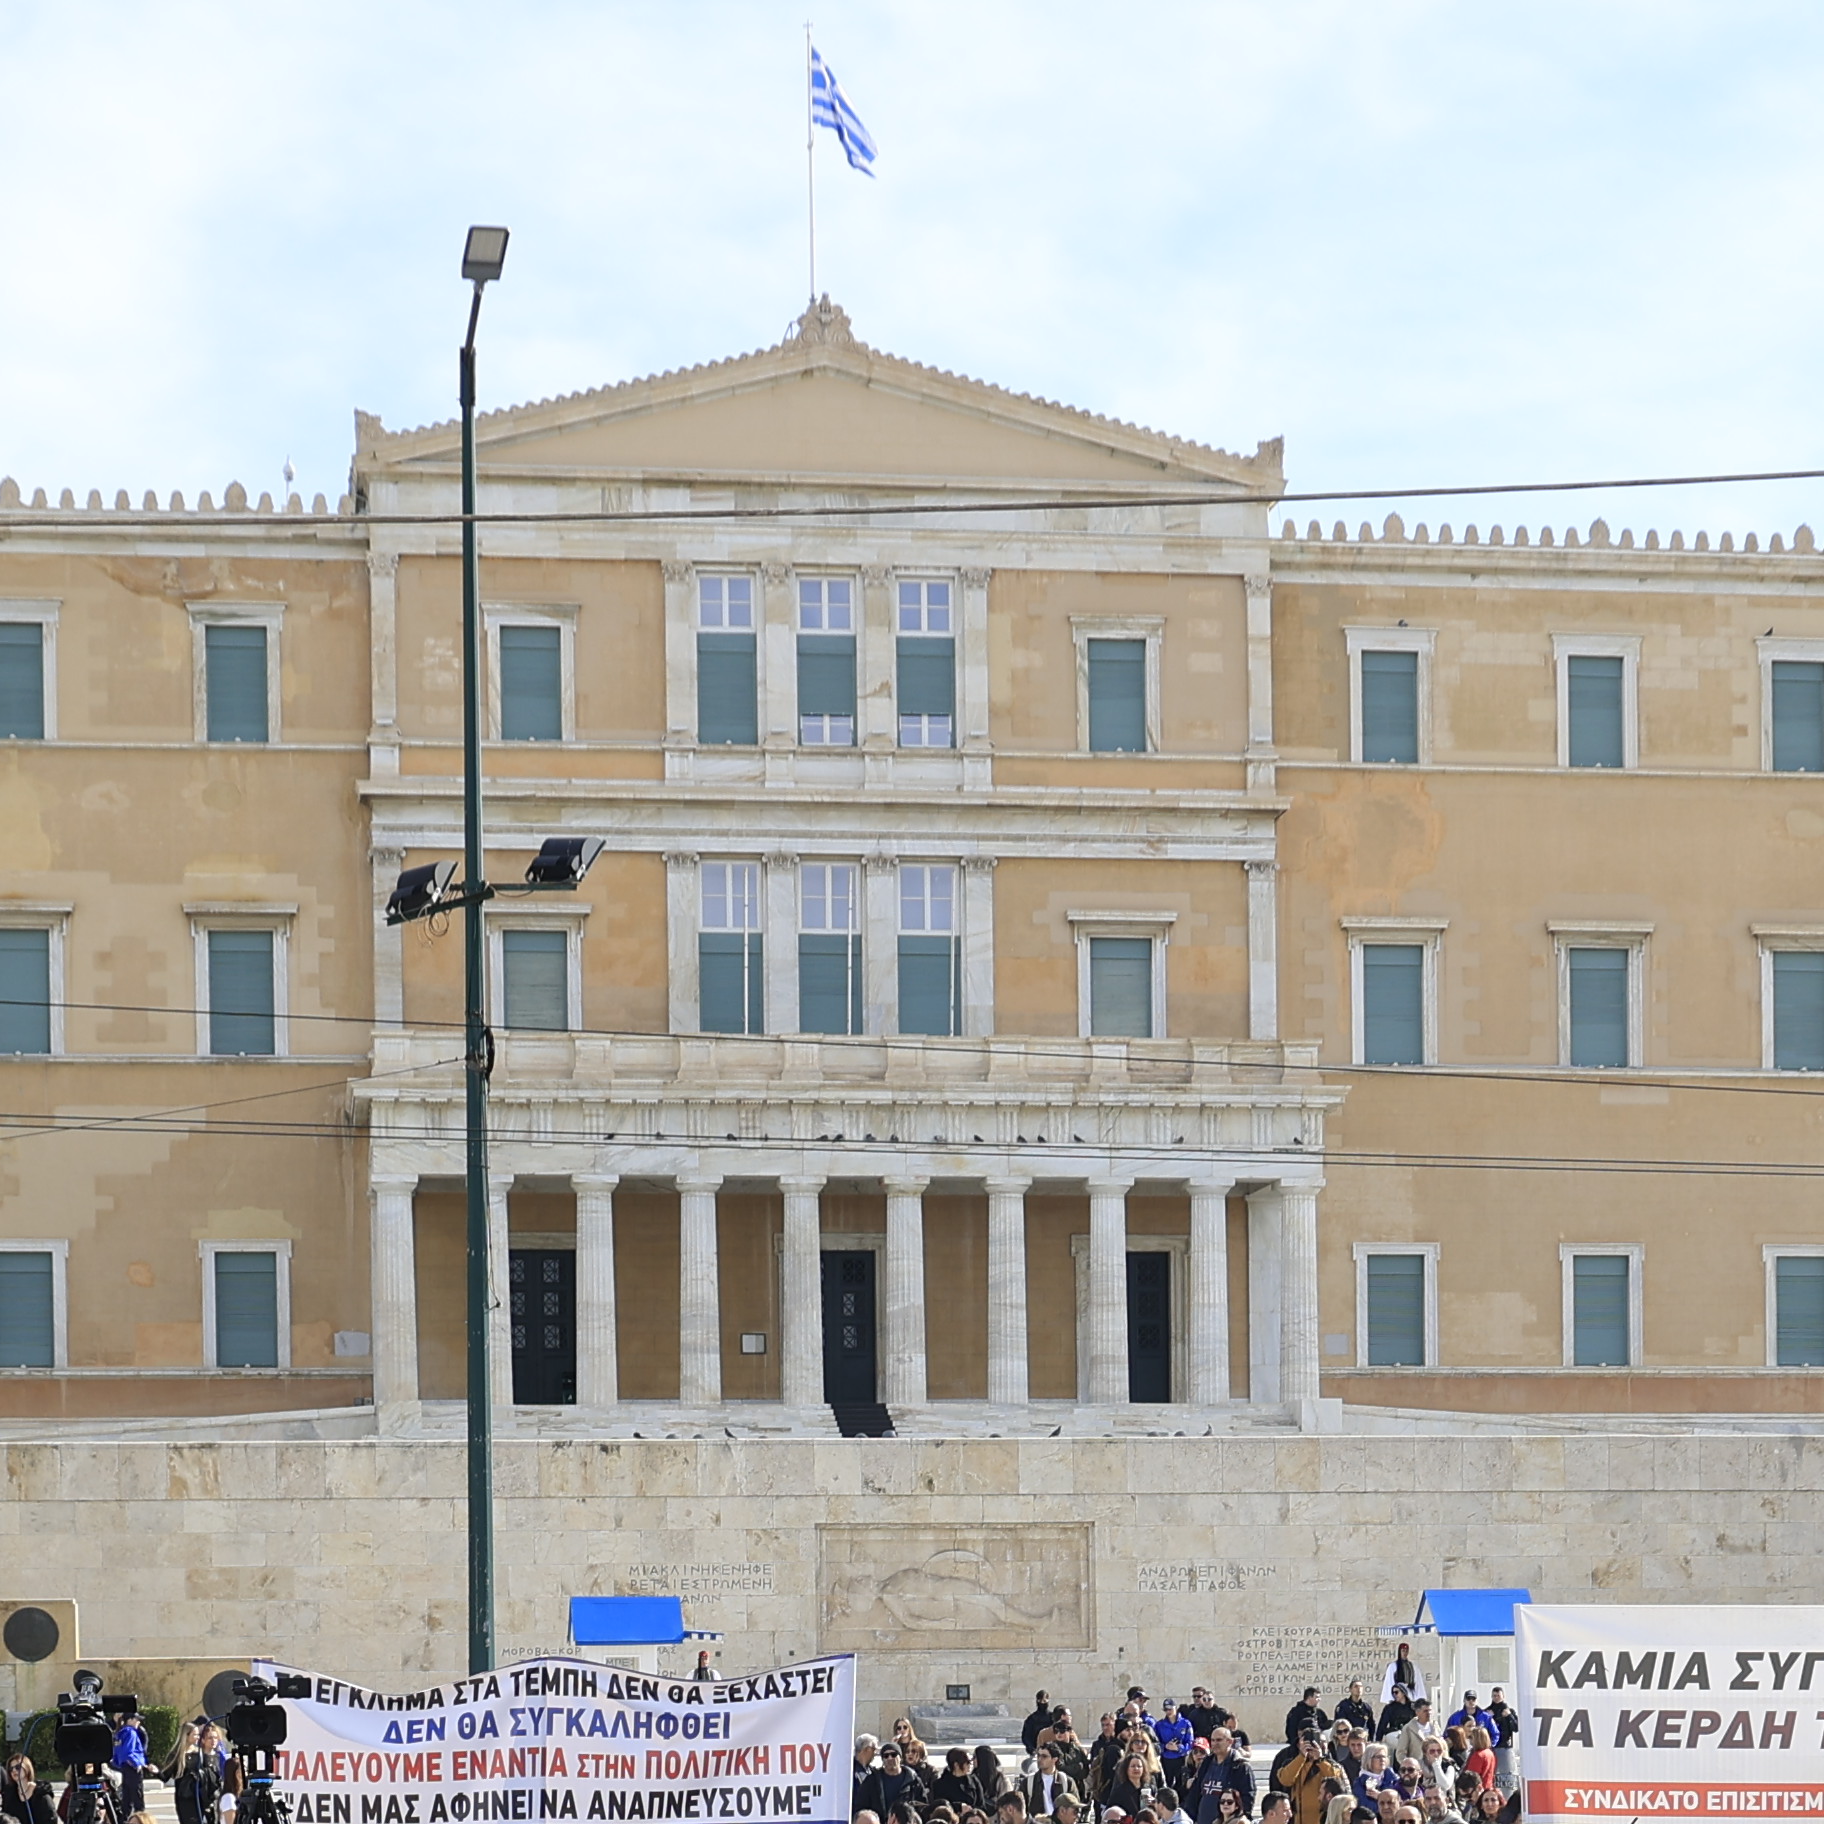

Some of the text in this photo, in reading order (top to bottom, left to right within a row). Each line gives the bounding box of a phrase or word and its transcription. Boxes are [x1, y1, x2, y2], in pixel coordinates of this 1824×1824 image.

[453, 1674, 501, 1703] ΣΤΑ
[510, 1666, 597, 1698] ΤΕΜΠΗ
[607, 1674, 660, 1702] ΔΕΝ
[1536, 1650, 1709, 1691] ΚΑΜΙΑ
[382, 1706, 731, 1744] ΔΕΝ ΘΑ ΣΥΓΚΑΛΗΦΘΕΙ
[1533, 1708, 1593, 1749] ΤΑ
[1613, 1708, 1798, 1749] ΚΕΡΔΗ
[276, 1742, 832, 1784] ΠΑΛΕΥΟΥΜΕ ΕΝΑΝΤΙΑ ΣΤΗΝ ΠΟΛΙΤΙΚΗ ΠΟΥ
[361, 1793, 421, 1823] ΜΑΣ
[429, 1790, 534, 1822] ΑΦΗΝΕΙ
[539, 1789, 578, 1820] ΝΑ
[587, 1784, 823, 1822] ΑΝΑΠΝΕΥΣΟΥΜΕ"
[1564, 1787, 1699, 1811] ΣΥΝΔΙΚΑΤΟ
